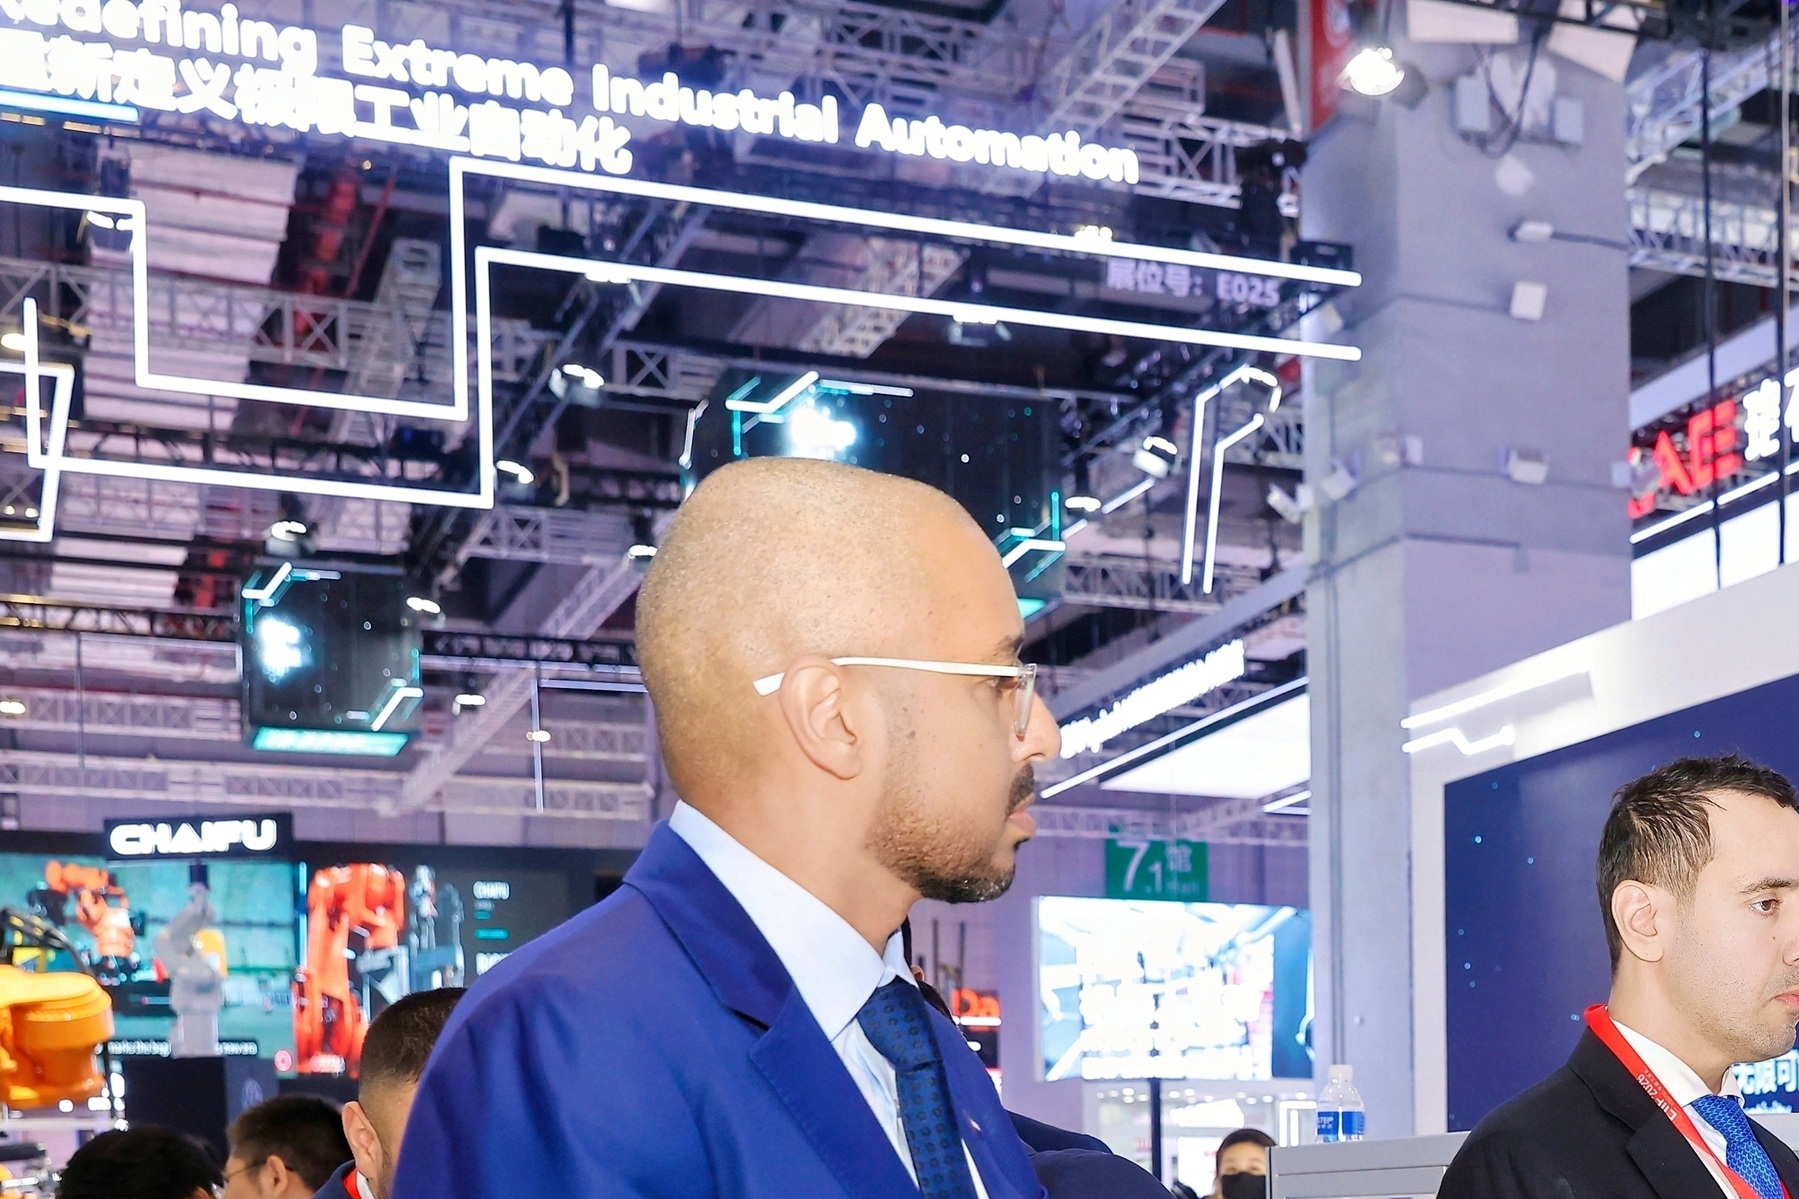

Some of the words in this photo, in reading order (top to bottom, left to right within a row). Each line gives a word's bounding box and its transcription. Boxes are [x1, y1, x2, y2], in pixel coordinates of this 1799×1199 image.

[0, 0, 317, 77] edefining
[343, 24, 573, 106] Extreme
[593, 63, 838, 144] Industrial
[855, 103, 1140, 184] Automation
[1216, 271, 1280, 307] E025
[110, 819, 277, 855] CHAIFU
